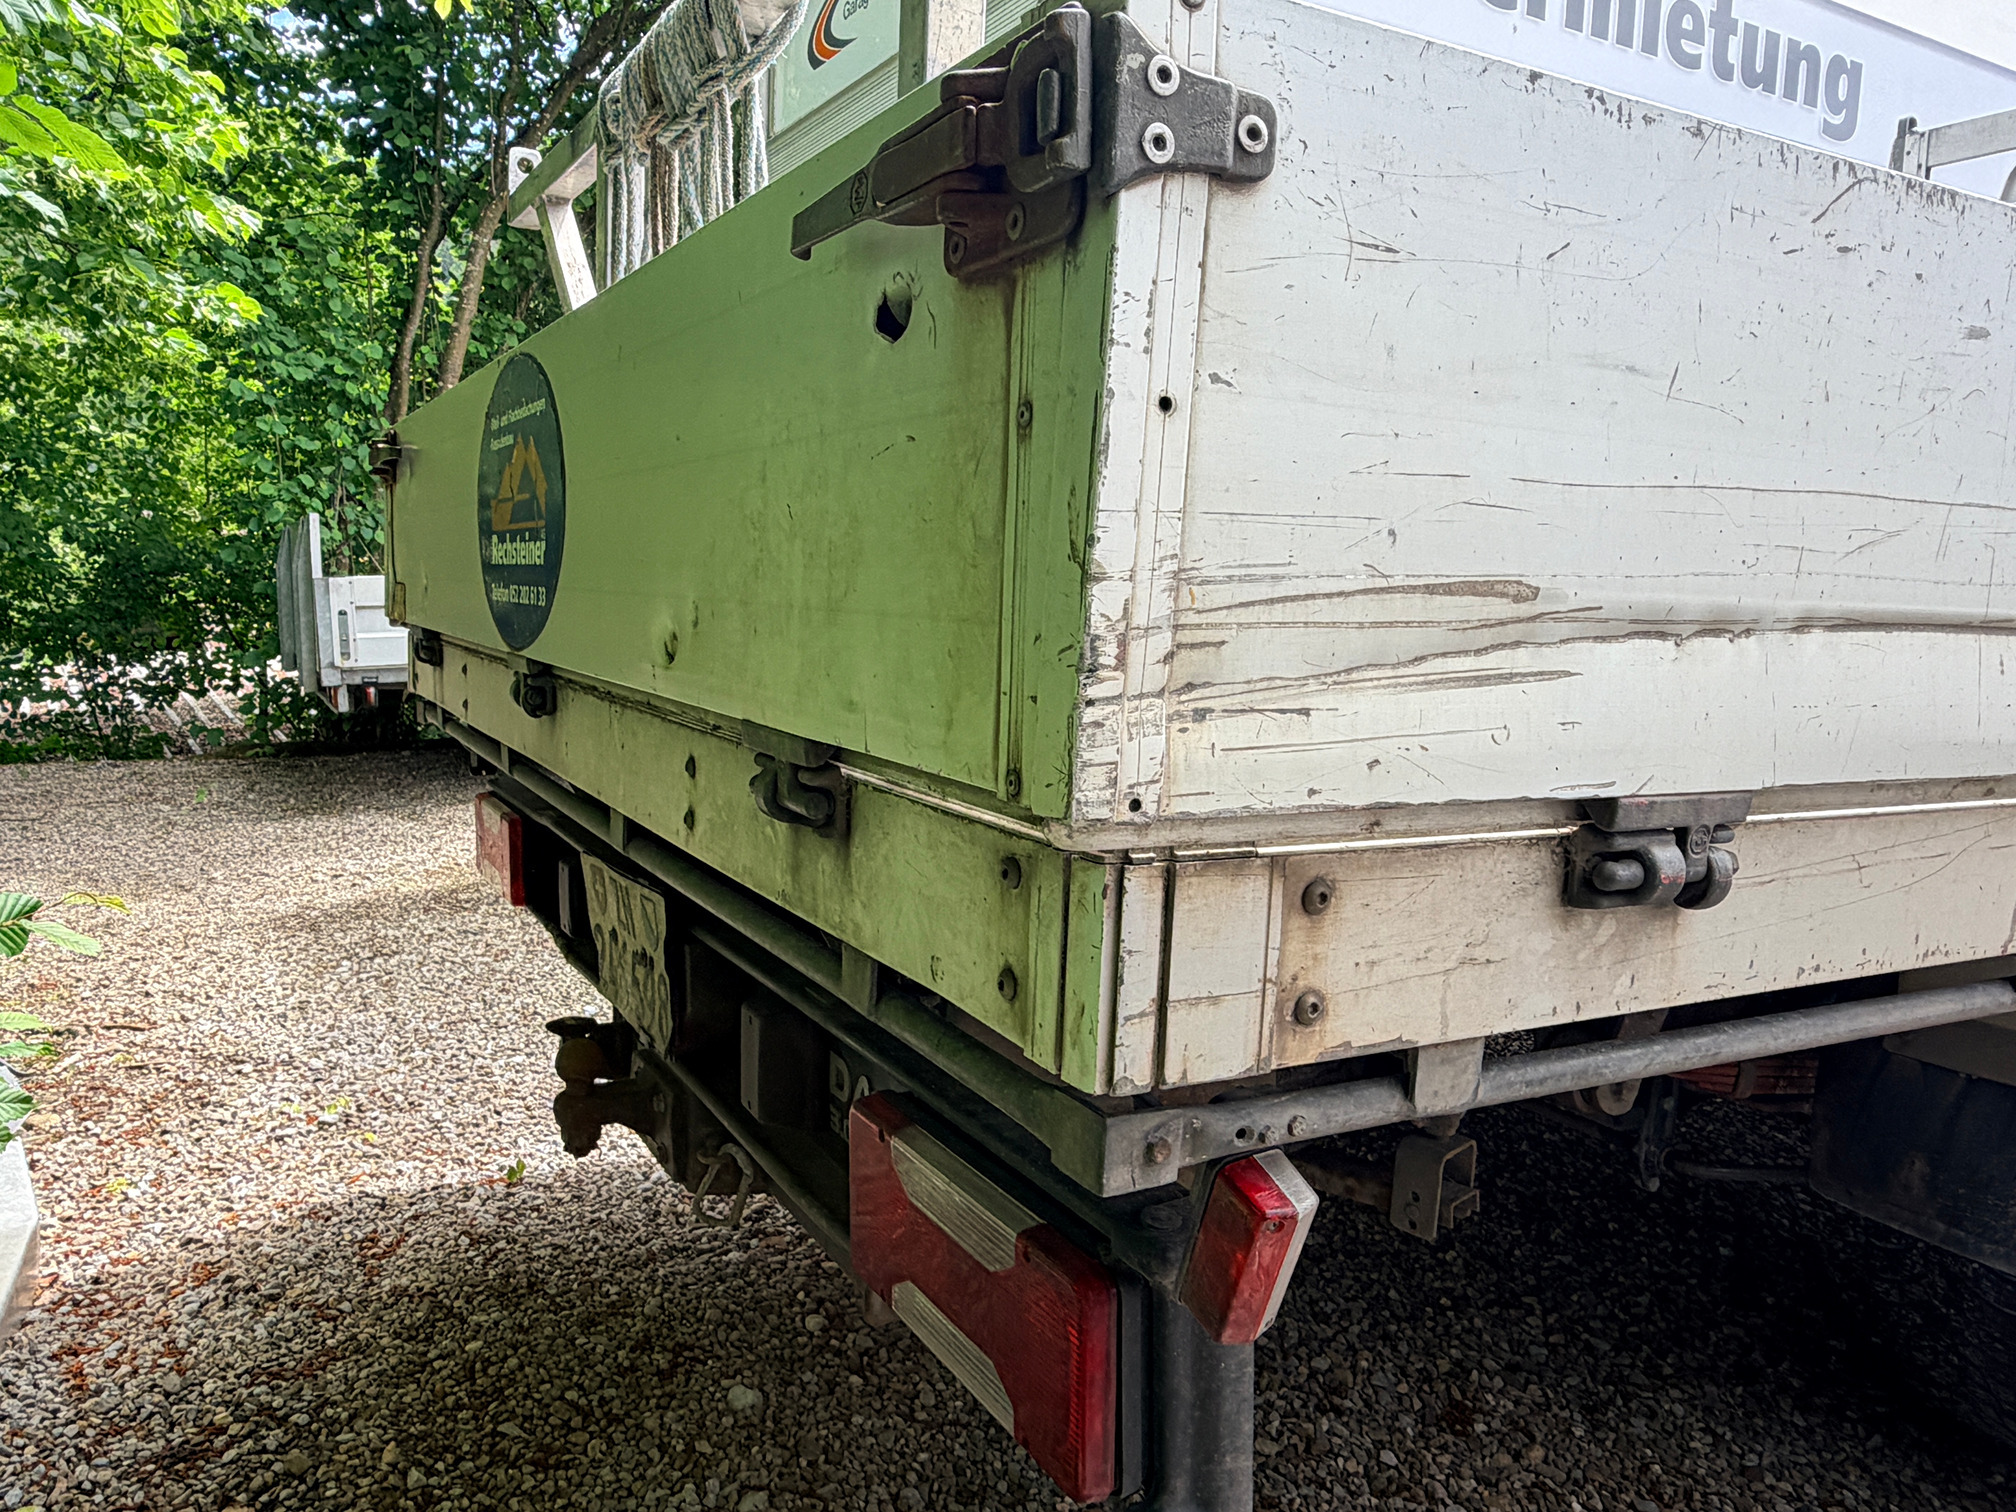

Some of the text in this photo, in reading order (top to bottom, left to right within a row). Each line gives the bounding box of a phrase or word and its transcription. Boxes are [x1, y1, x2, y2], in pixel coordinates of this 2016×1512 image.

[491, 531, 546, 565] Rechsteiner
[519, 585, 530, 605] 202
[530, 585, 538, 606] 61
[537, 586, 546, 607] 33
